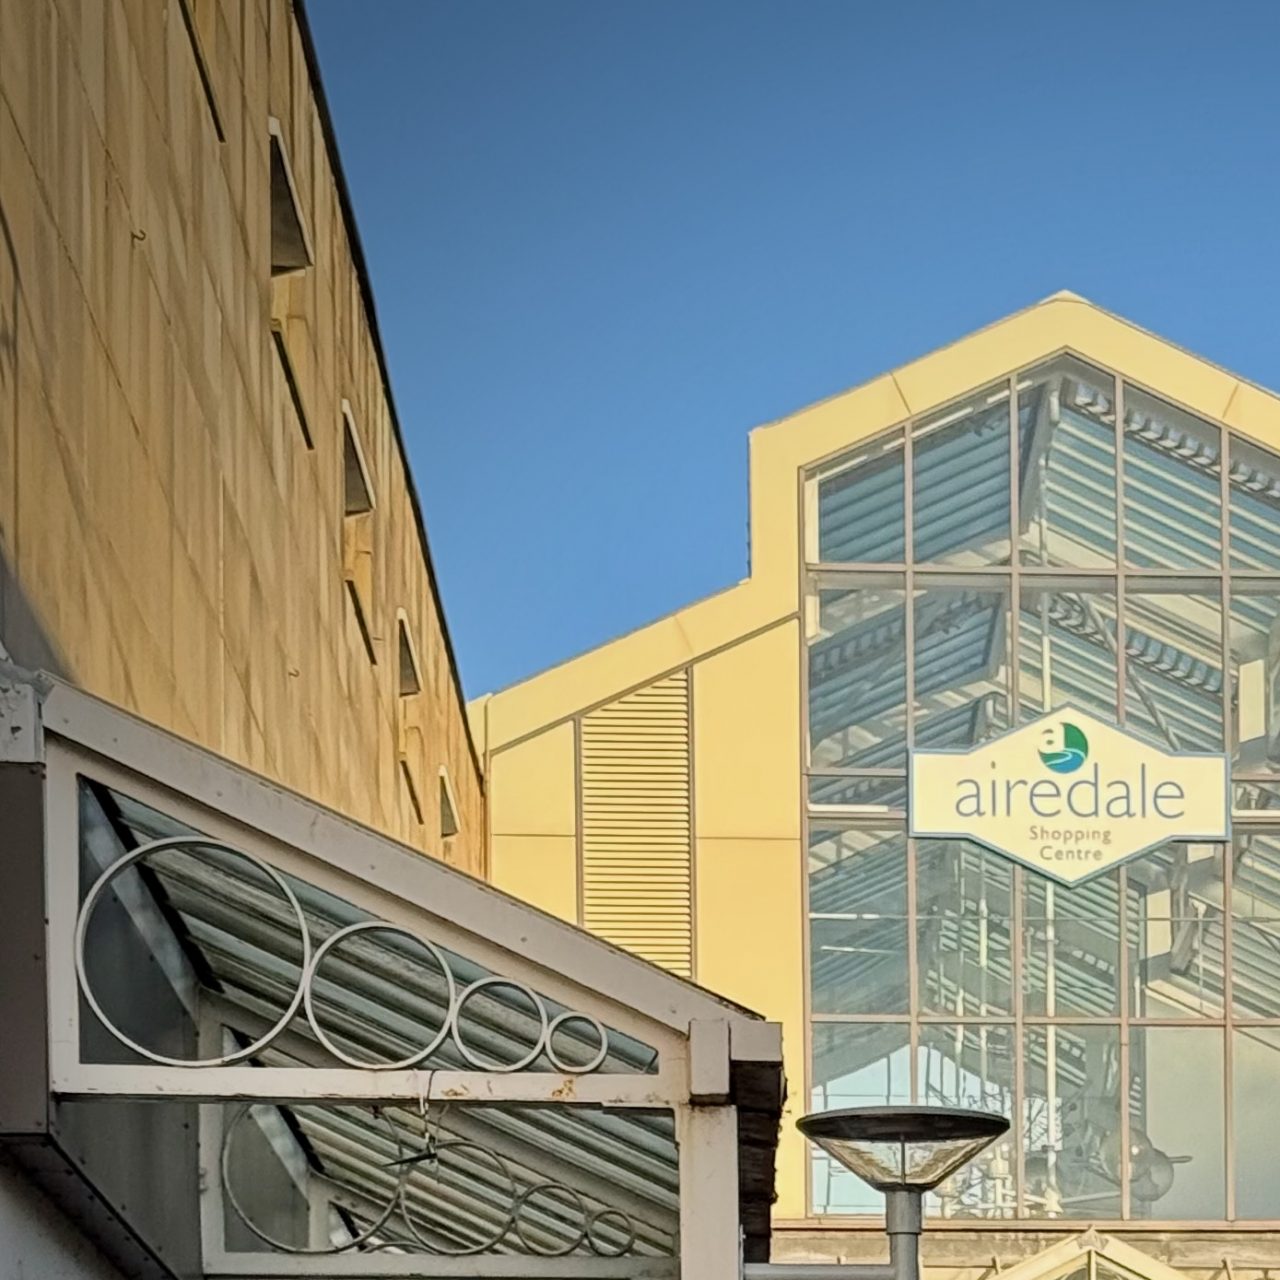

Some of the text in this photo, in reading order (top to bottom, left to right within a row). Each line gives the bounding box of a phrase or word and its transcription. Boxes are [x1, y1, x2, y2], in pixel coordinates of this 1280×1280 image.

[955, 761, 1185, 818] airedale
[1029, 825, 1112, 845] Shopping
[1040, 846, 1103, 861] Centre
